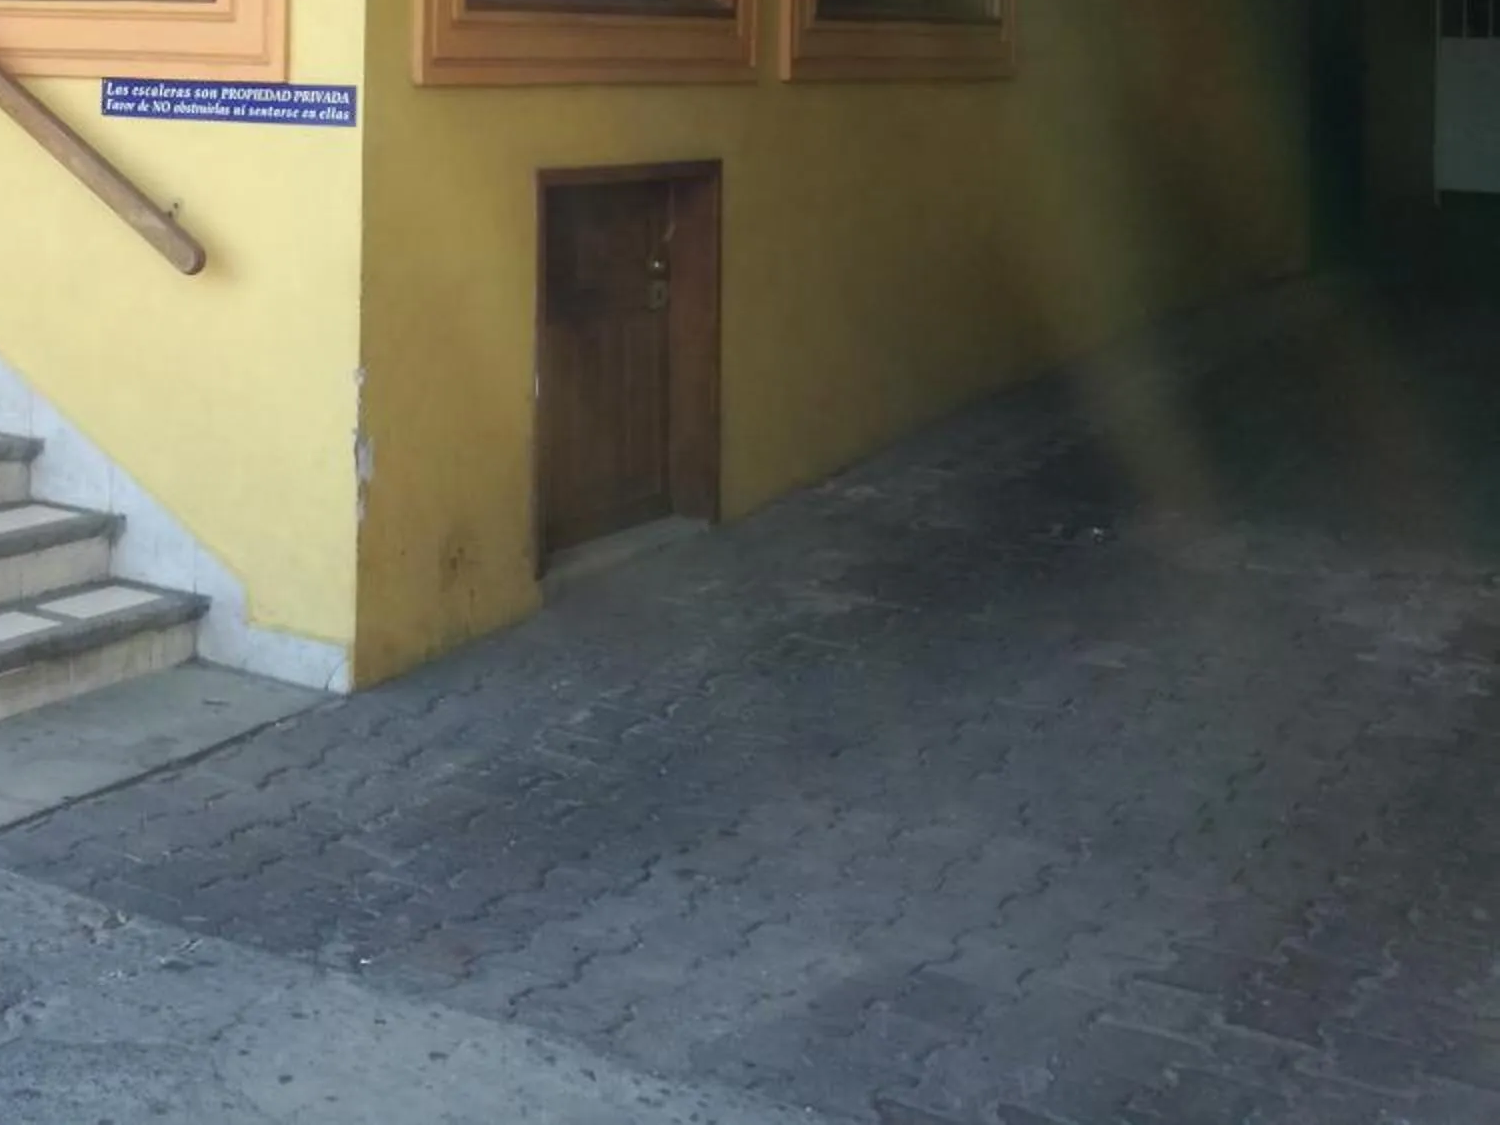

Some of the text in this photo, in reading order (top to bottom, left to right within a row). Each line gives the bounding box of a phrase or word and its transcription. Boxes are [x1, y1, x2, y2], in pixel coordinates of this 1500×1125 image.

[106, 82, 349, 105] Las escaleras son PROPIEDAD PRIVADA
[106, 99, 136, 112] Favor
[137, 100, 150, 112] de
[152, 100, 171, 113] NO
[233, 103, 246, 116] ni
[249, 106, 298, 119] sentarse
[301, 108, 317, 119] en
[319, 106, 350, 121] ellas
